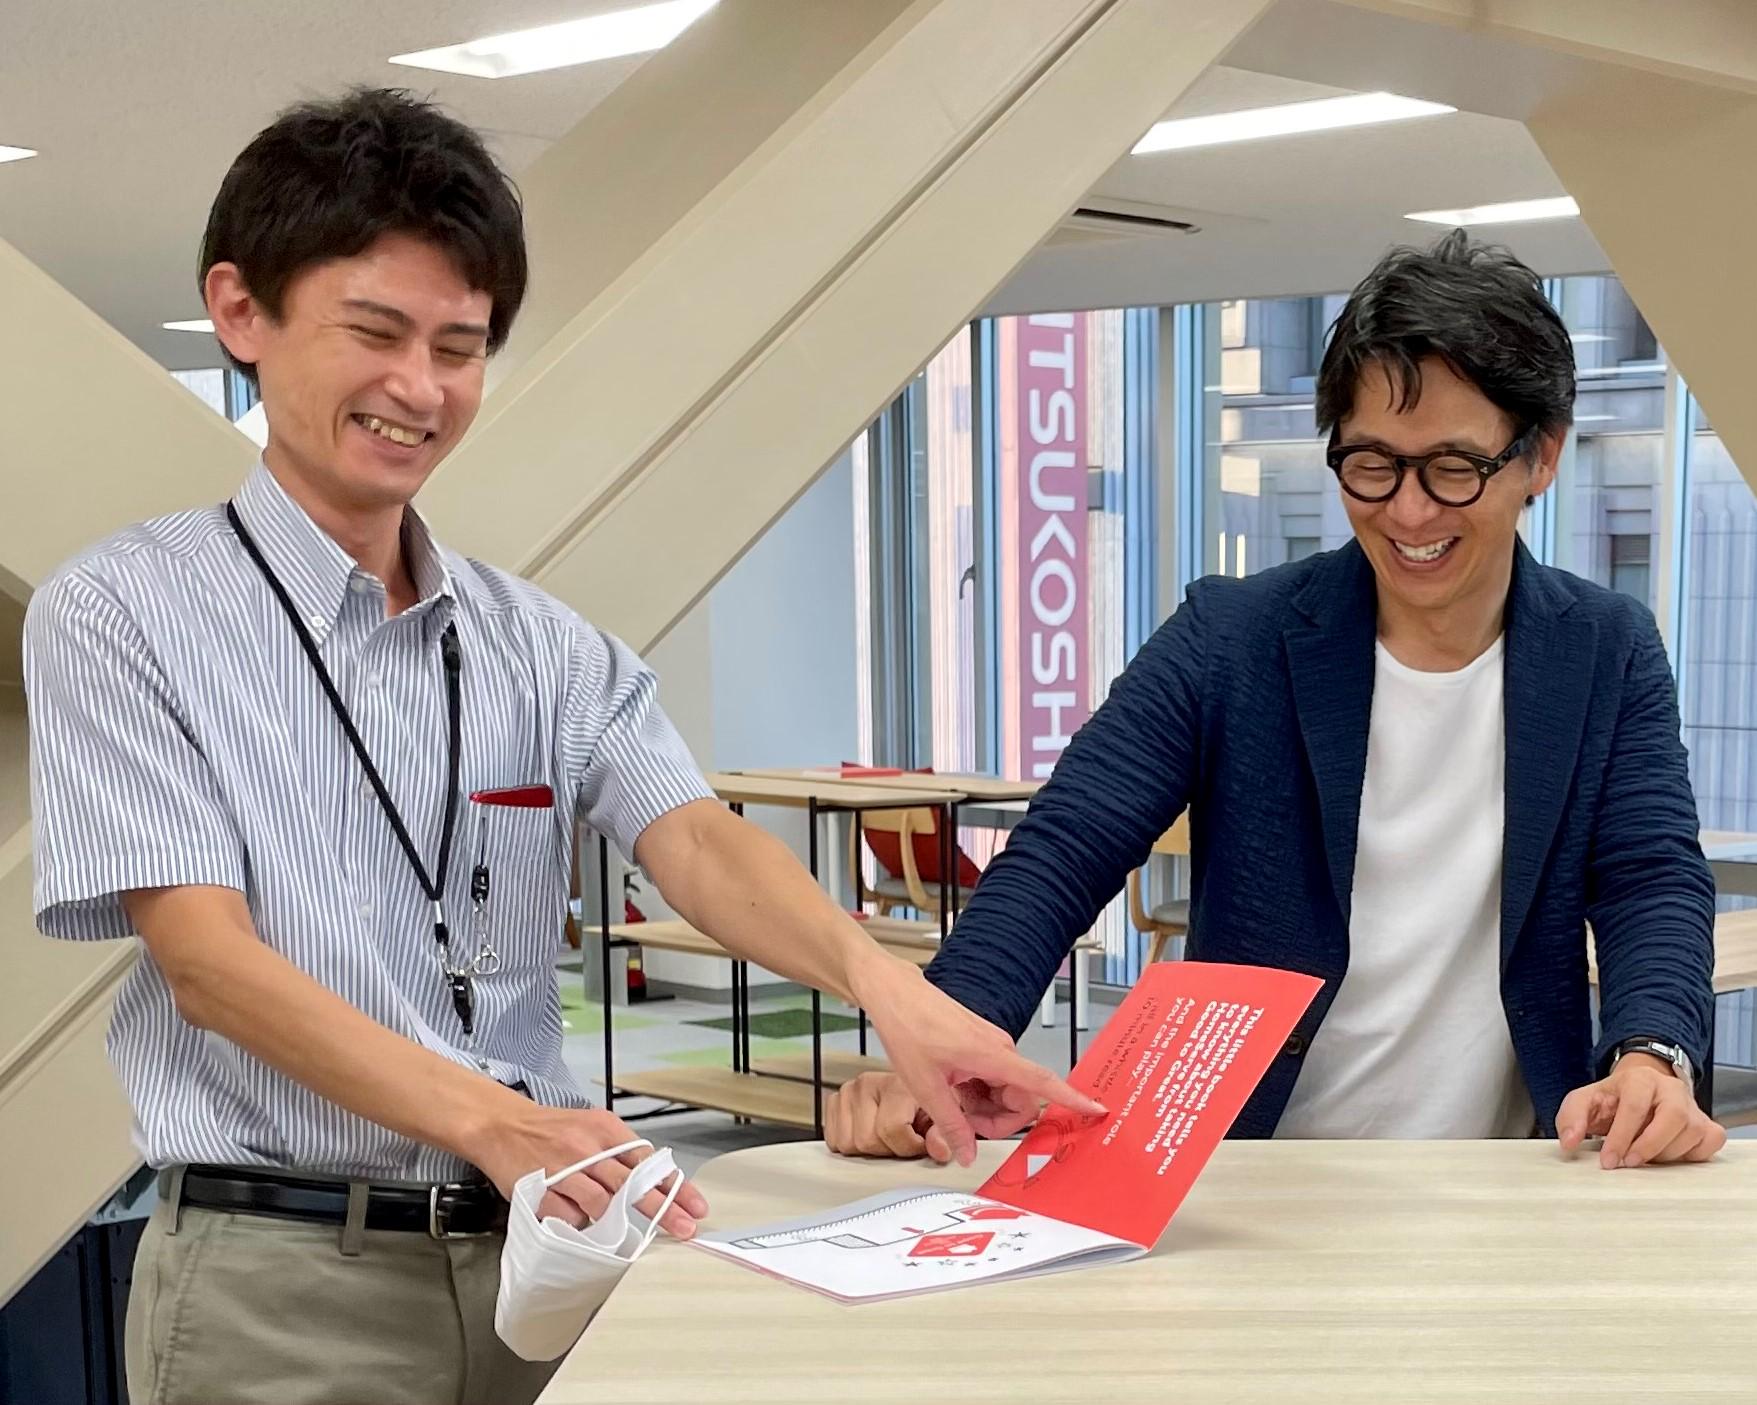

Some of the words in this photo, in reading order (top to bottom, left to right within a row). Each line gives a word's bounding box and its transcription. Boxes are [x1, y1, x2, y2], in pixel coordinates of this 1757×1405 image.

[1166, 997, 1185, 1022] you
[1176, 998, 1195, 1025] And
[1190, 1000, 1217, 1039] Good
[1226, 1003, 1240, 1019] to
[1240, 1008, 1264, 1036] This
[1151, 1024, 1167, 1048] can
[1161, 1027, 1179, 1049] the
[1177, 1002, 1229, 1081] HomeServe
[1180, 1041, 1193, 1057] to
[1201, 1022, 1229, 1060] know
[1201, 1005, 1250, 1079] everything
[1218, 1039, 1245, 1072] little
[1121, 1052, 1165, 1117] important
[1175, 1063, 1203, 1105] about
[1184, 1082, 1204, 1109] you
[1195, 1075, 1223, 1111] book
[1155, 1083, 1181, 1118] from
[1102, 1119, 1123, 1146] role
[1145, 1108, 1178, 1153] taking
[1162, 1112, 1187, 1147] need
[1176, 1115, 1198, 1145] tells
[1157, 1147, 1178, 1175] you
